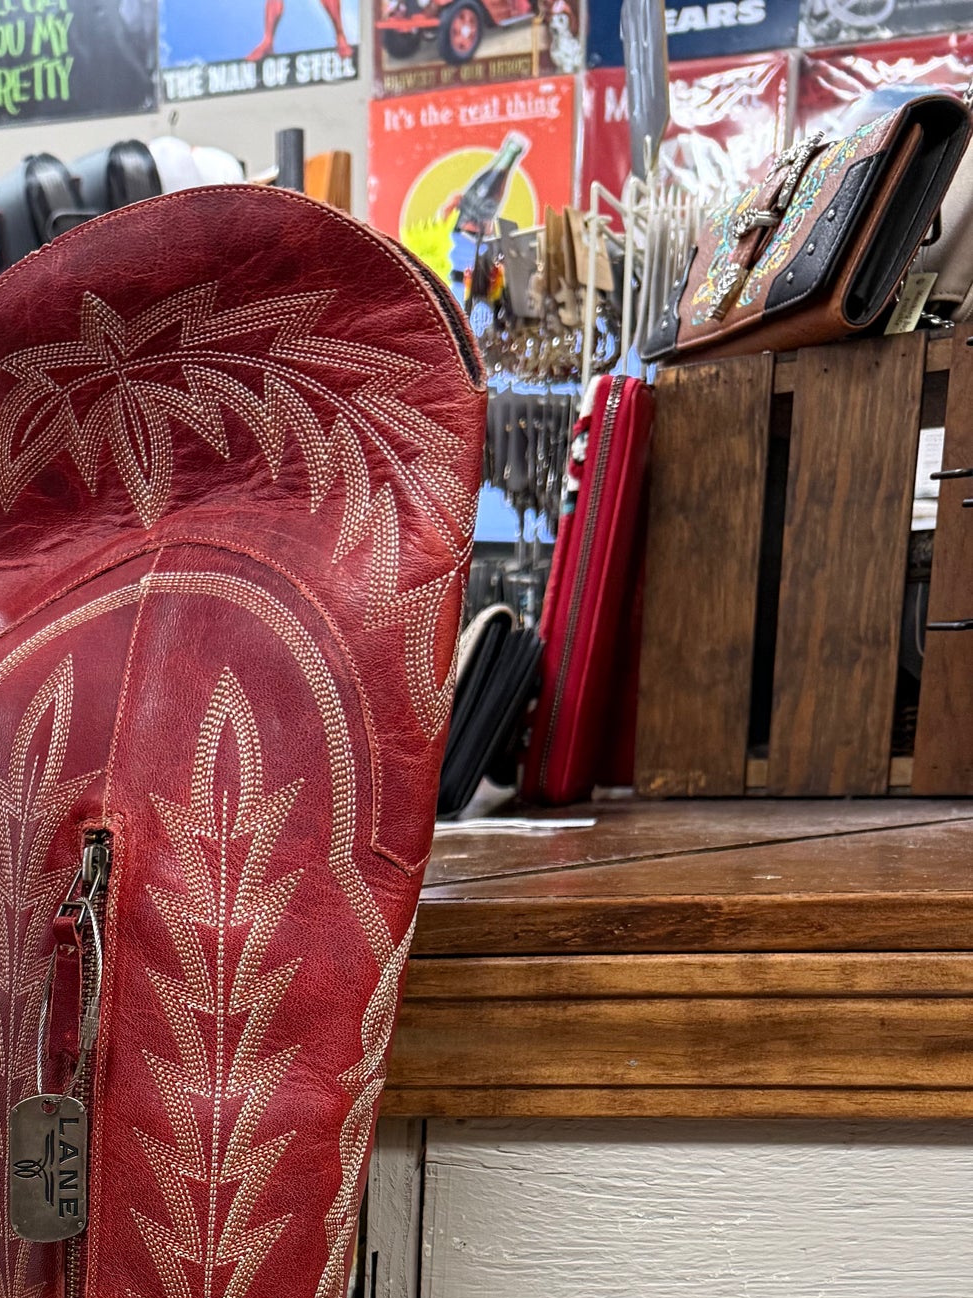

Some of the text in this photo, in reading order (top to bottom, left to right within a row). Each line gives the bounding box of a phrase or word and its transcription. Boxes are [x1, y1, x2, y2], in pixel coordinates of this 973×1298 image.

[31, 12, 74, 57] MY
[664, 1, 767, 34] EARS
[262, 55, 291, 88] OF
[383, 91, 562, 132] It's the real thing
[58, 1117, 80, 1219] LANE
